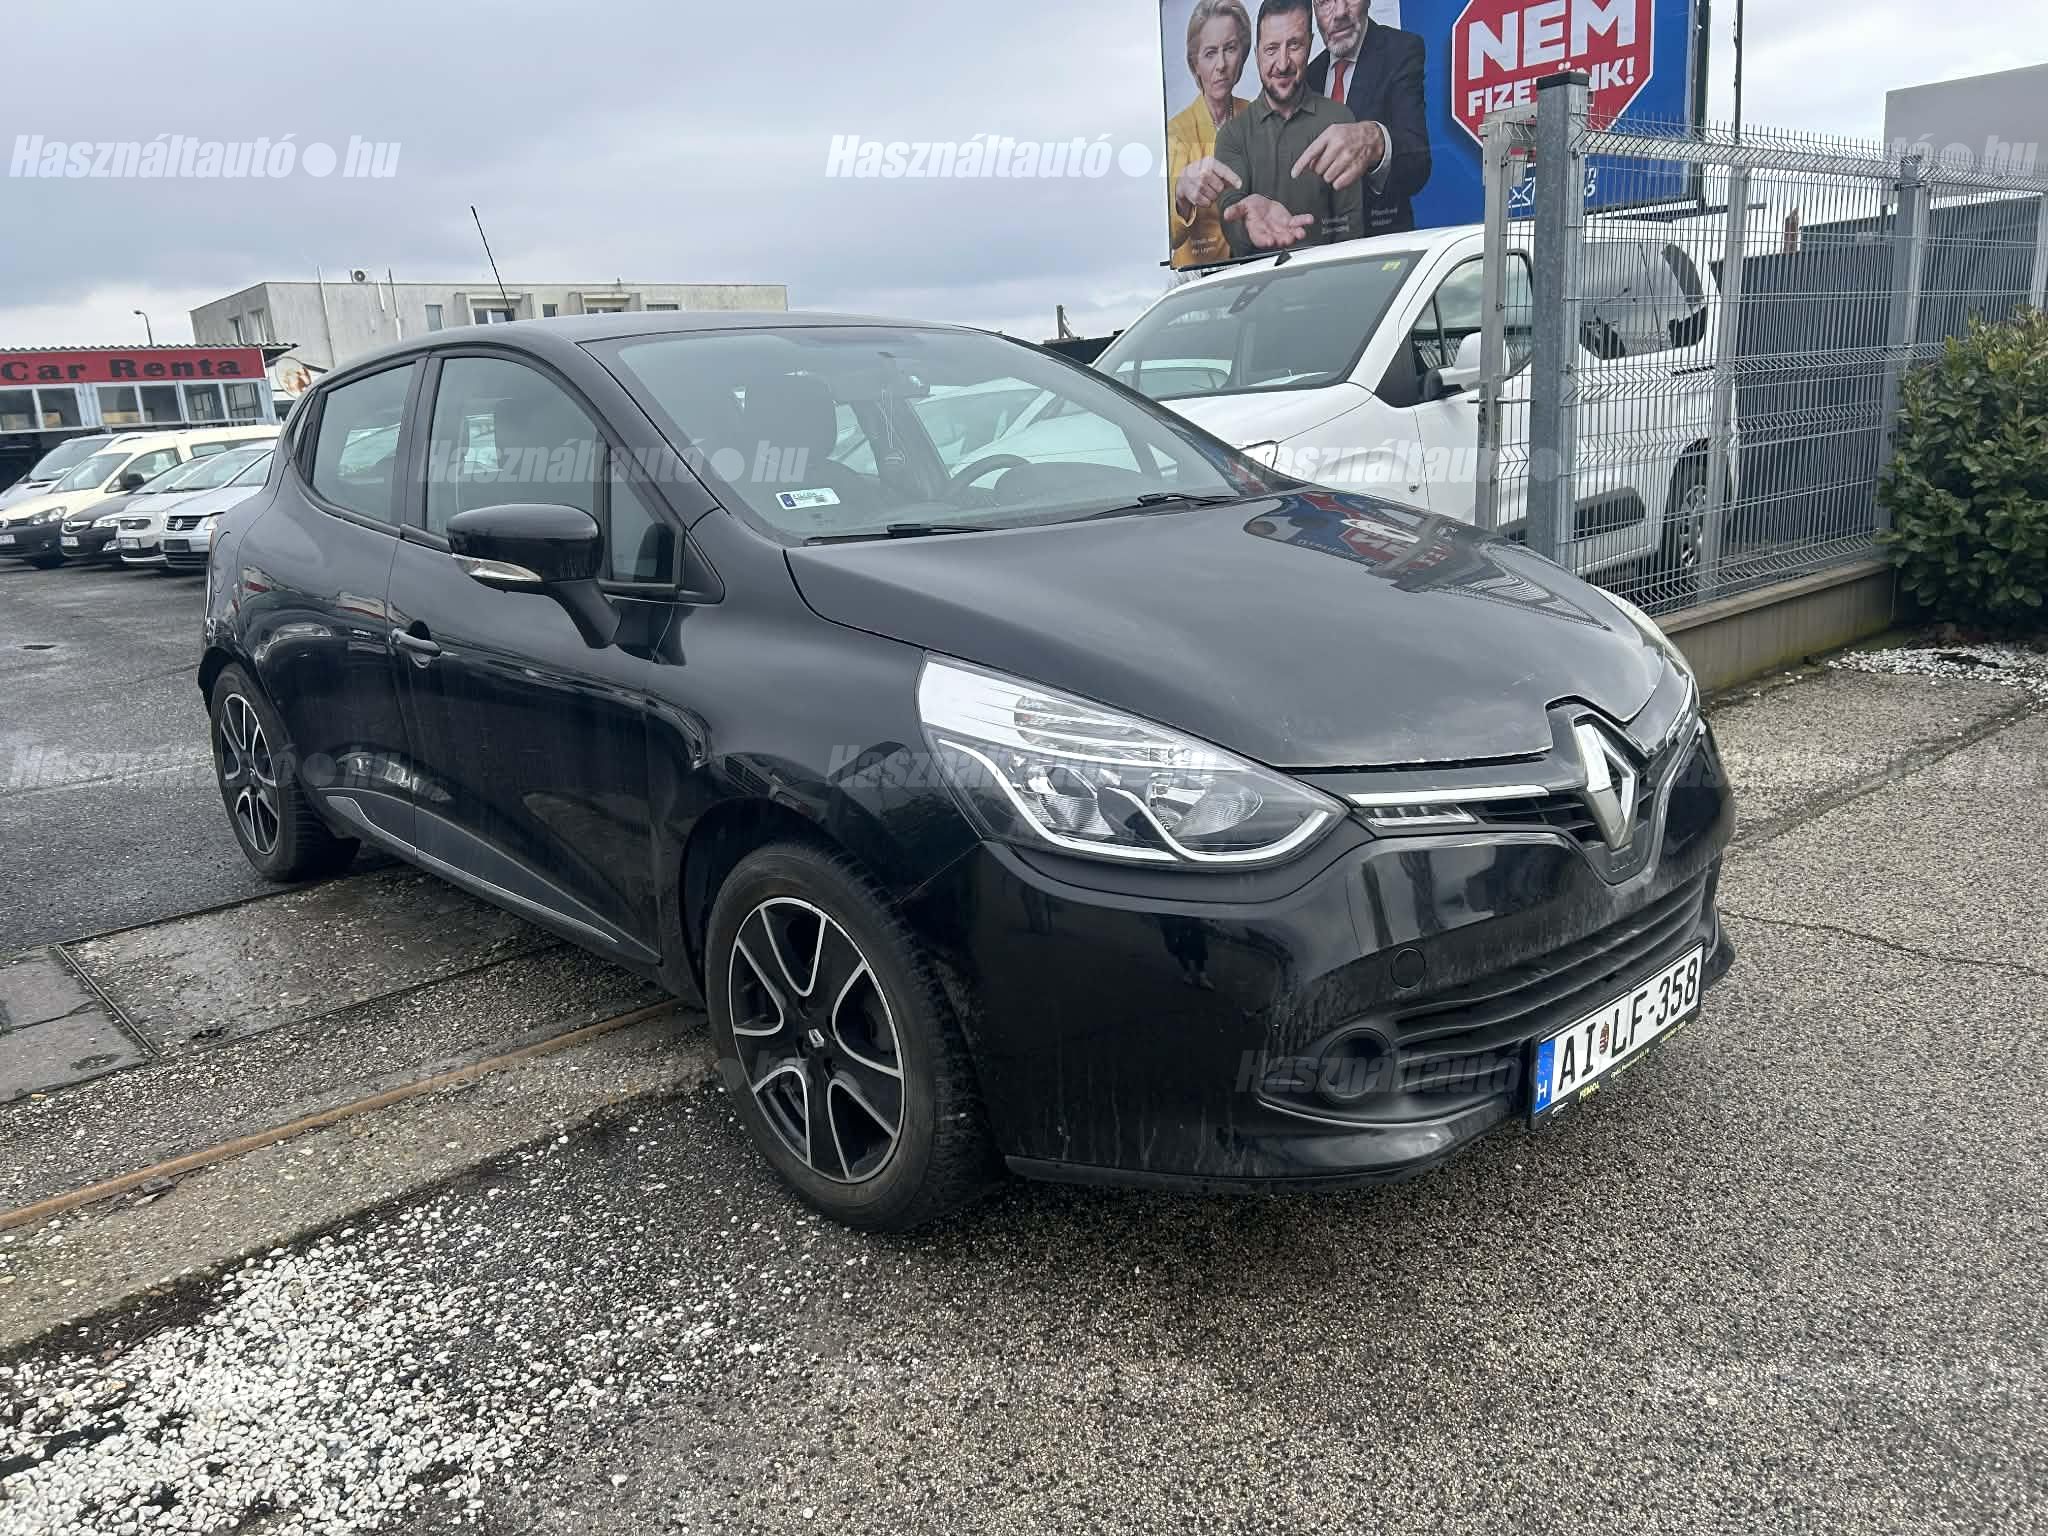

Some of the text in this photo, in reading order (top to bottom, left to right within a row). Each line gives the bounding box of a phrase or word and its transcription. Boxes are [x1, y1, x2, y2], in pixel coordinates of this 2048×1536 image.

[1468, 0, 1636, 81] NEM
[1468, 57, 1635, 117] FIZENK!
[1, 358, 241, 382] Car Renta
[1558, 956, 1699, 1092] AI LF-358
[1537, 1079, 1548, 1102] H
